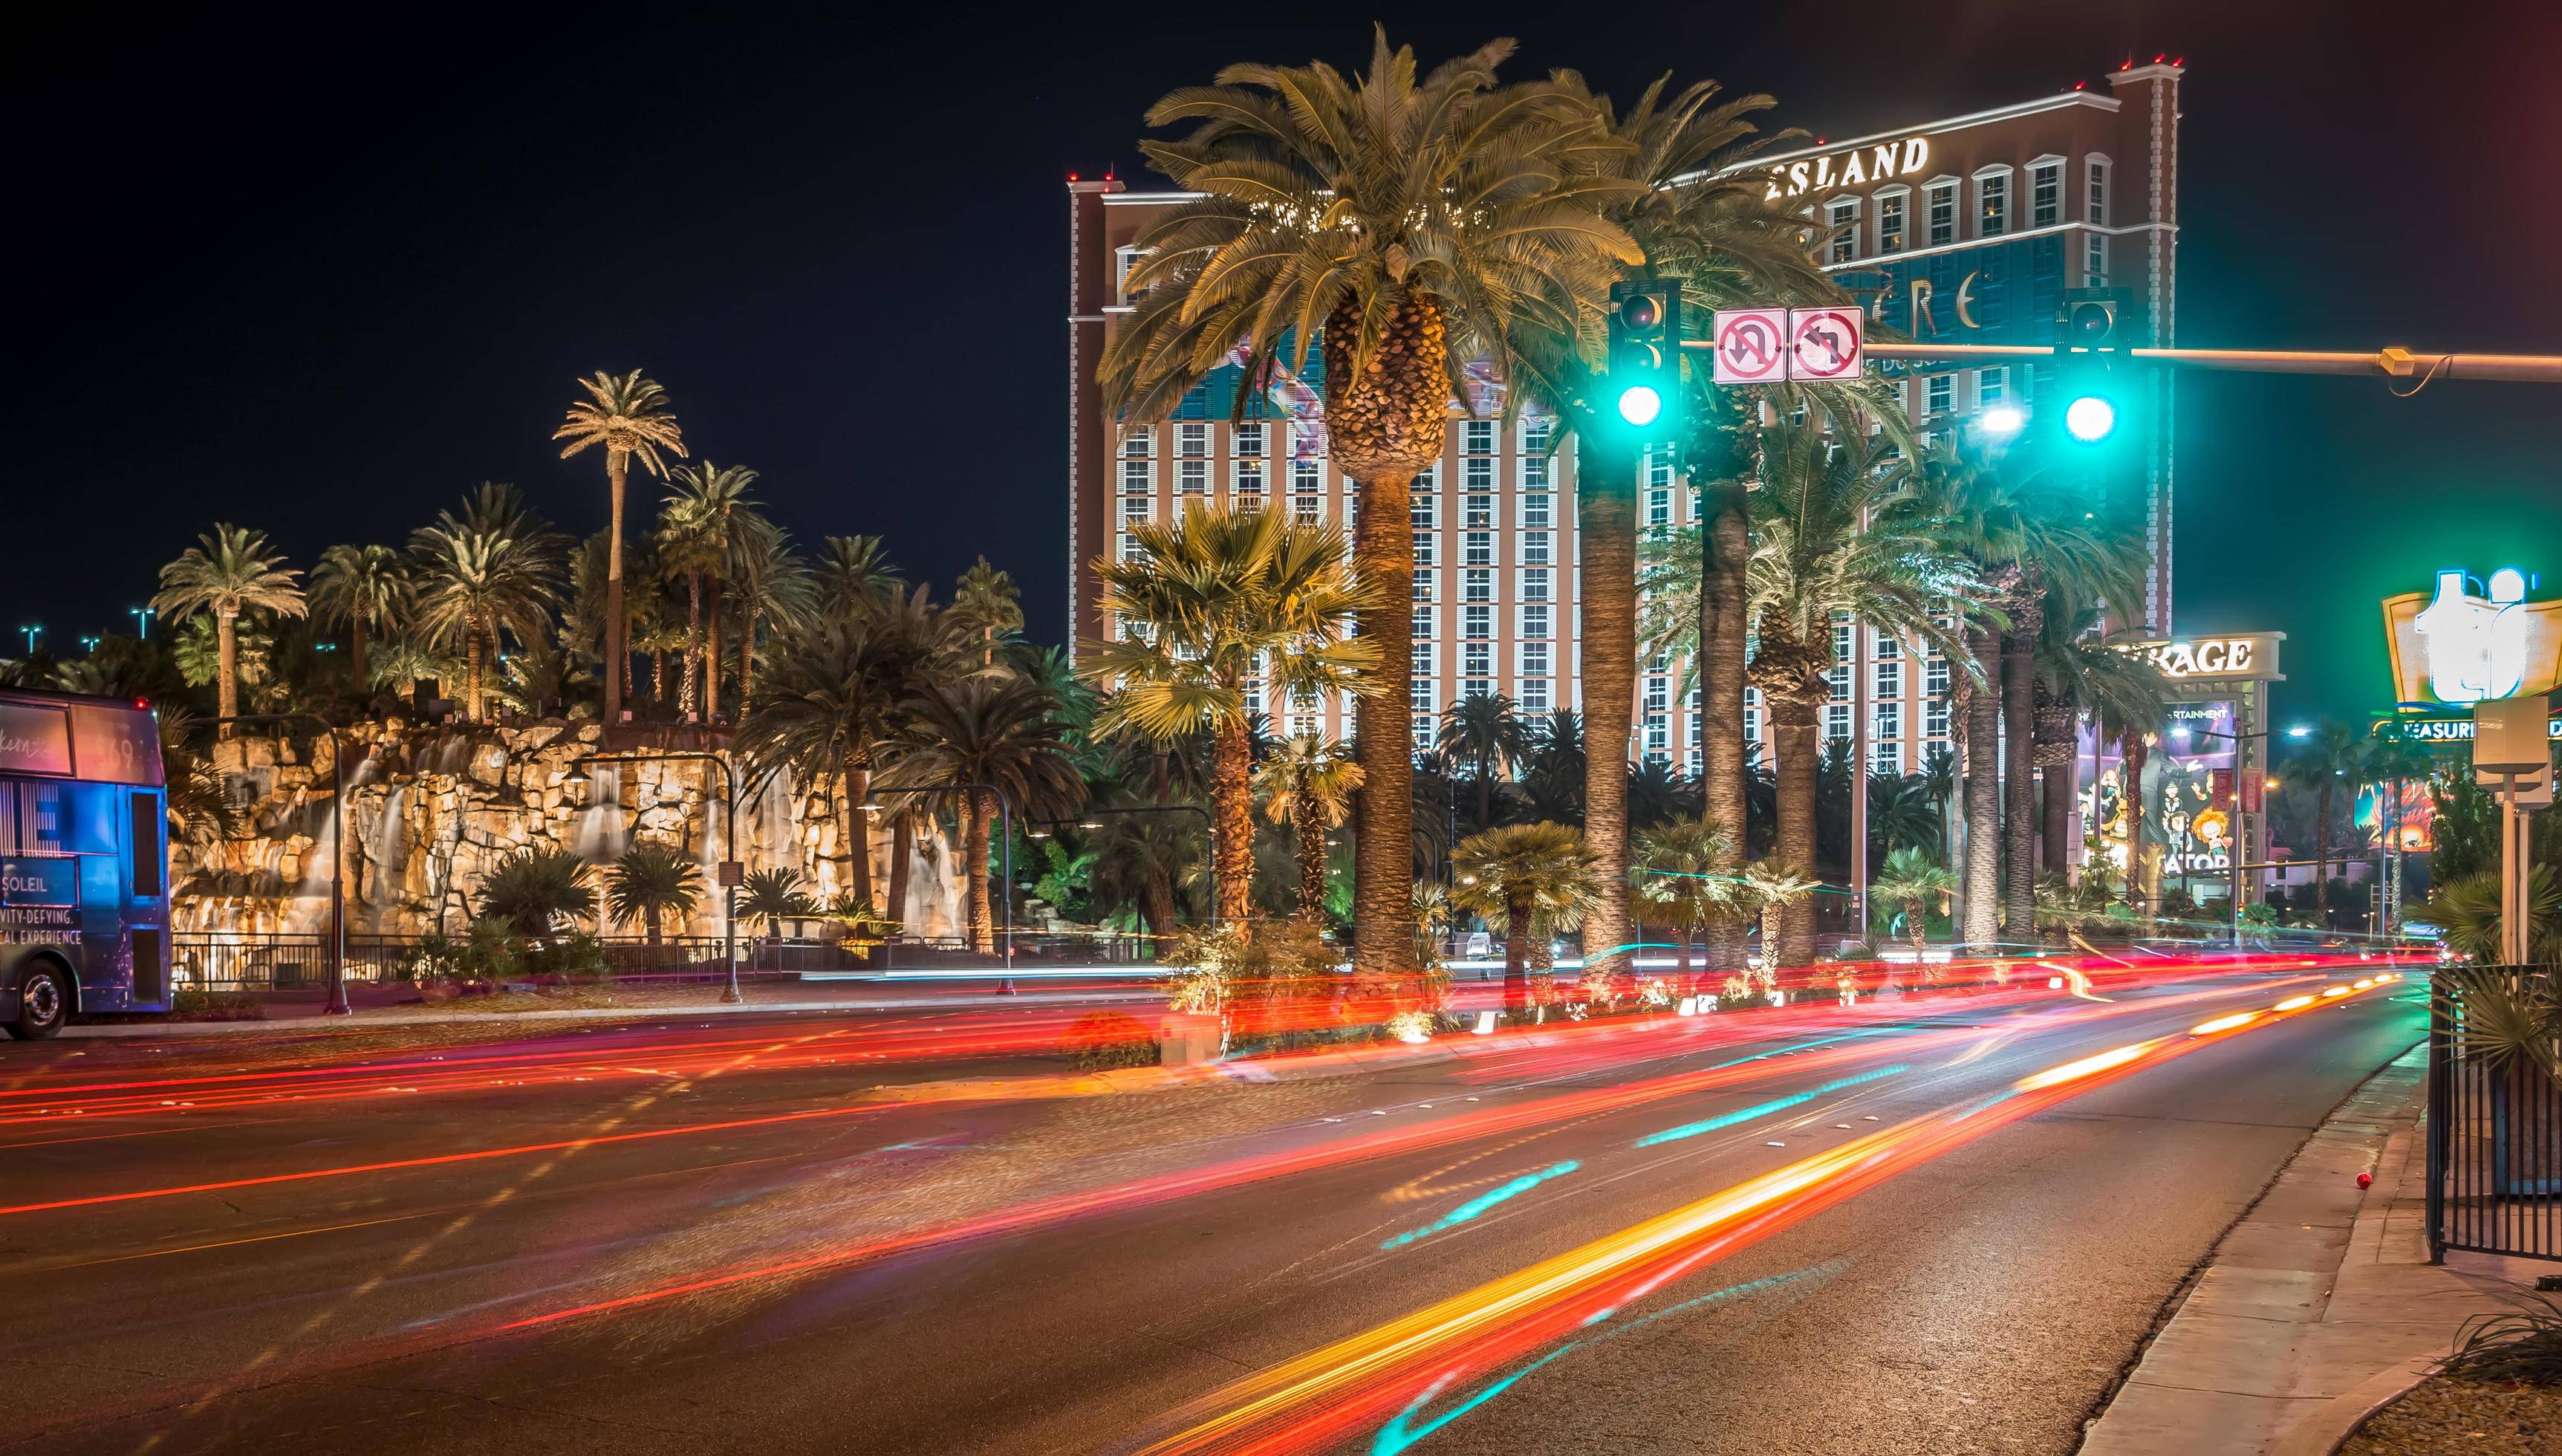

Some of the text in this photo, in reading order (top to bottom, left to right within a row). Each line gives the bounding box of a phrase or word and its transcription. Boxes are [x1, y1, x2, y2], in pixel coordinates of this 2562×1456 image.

[2168, 709, 2228, 719] RTAINMENT
[2402, 721, 2474, 740] EASUR
[2162, 854, 2230, 874] ATOR
[2, 877, 48, 892] SOLEIL
[20, 930, 82, 945] EXPERIENCE
